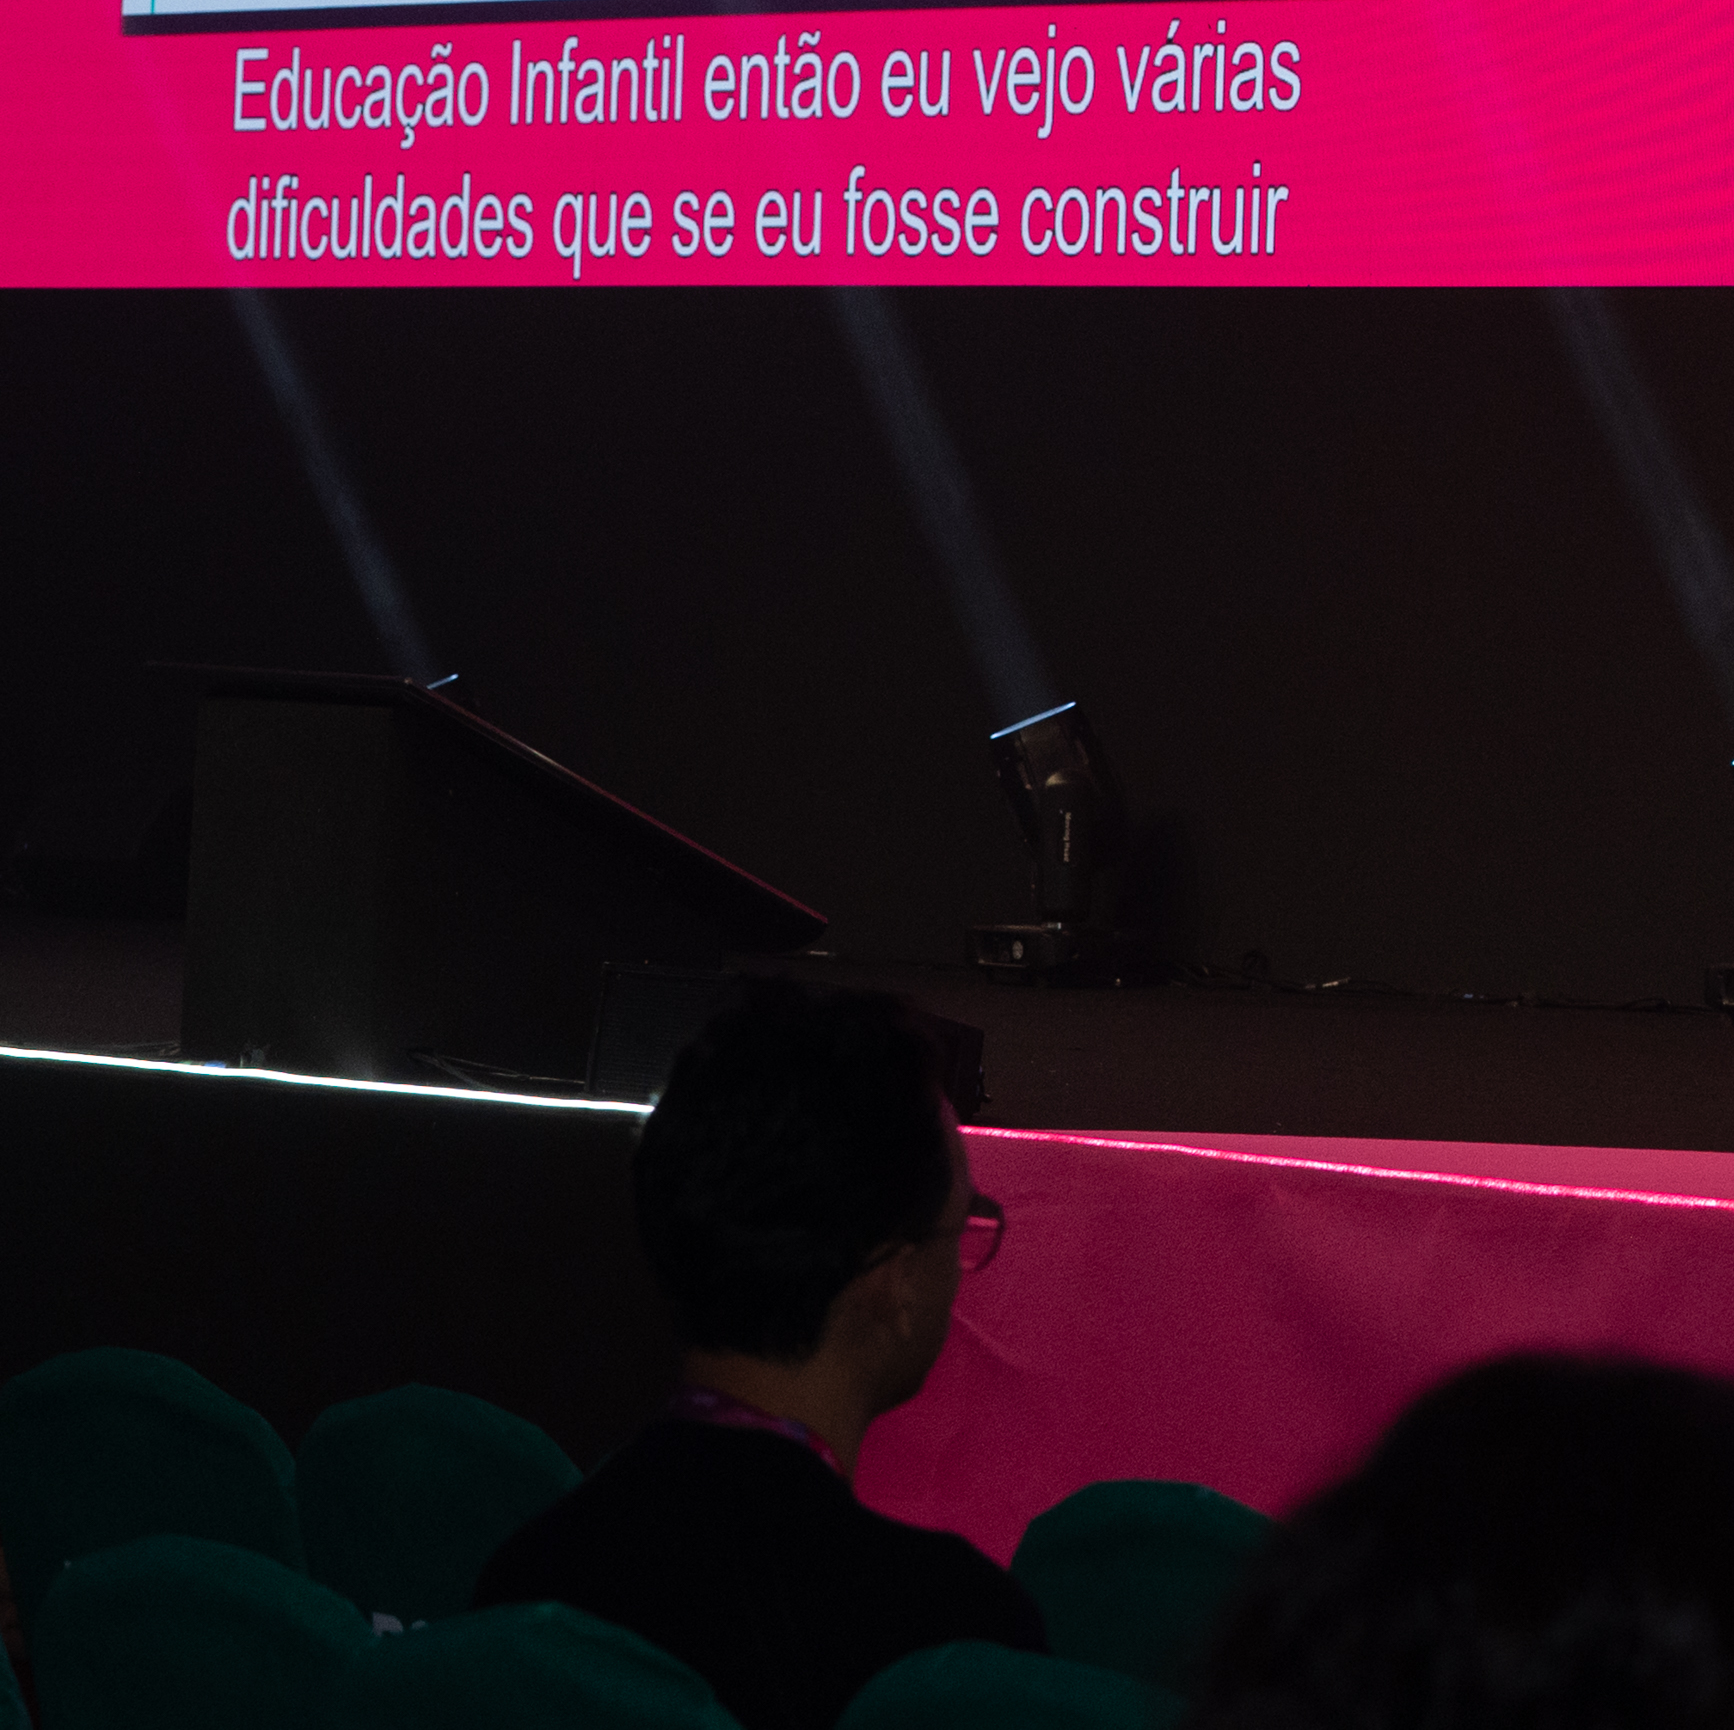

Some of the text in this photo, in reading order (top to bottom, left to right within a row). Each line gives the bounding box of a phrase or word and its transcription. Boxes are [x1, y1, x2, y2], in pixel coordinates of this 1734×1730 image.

[233, 19, 1301, 150] Educação Infantil então eu vejo várias
[226, 162, 1290, 280] dificuldades que se eu fosse construir
